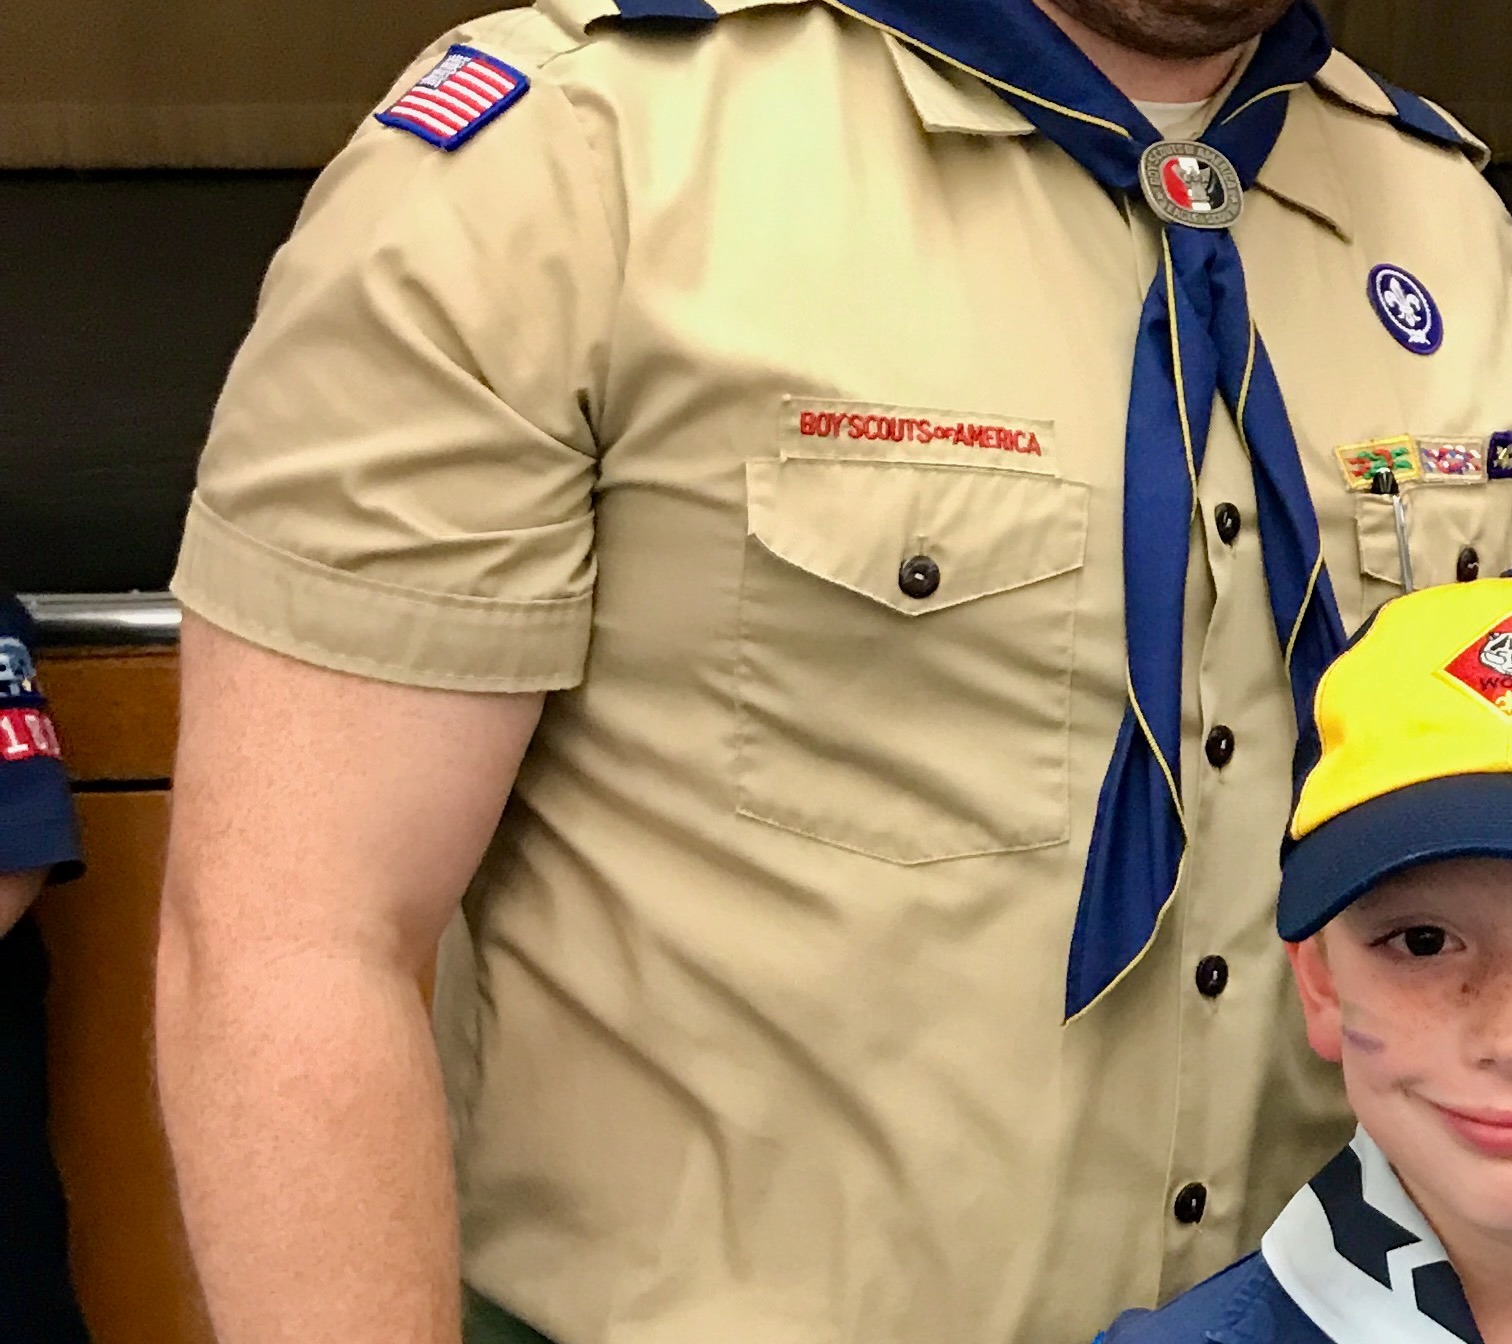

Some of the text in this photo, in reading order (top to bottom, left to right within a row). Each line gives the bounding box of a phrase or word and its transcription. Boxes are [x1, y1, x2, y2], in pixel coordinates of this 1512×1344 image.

[799, 410, 846, 439] BOY
[847, 412, 934, 445] SCOUTS
[953, 421, 1043, 458] AMERICA
